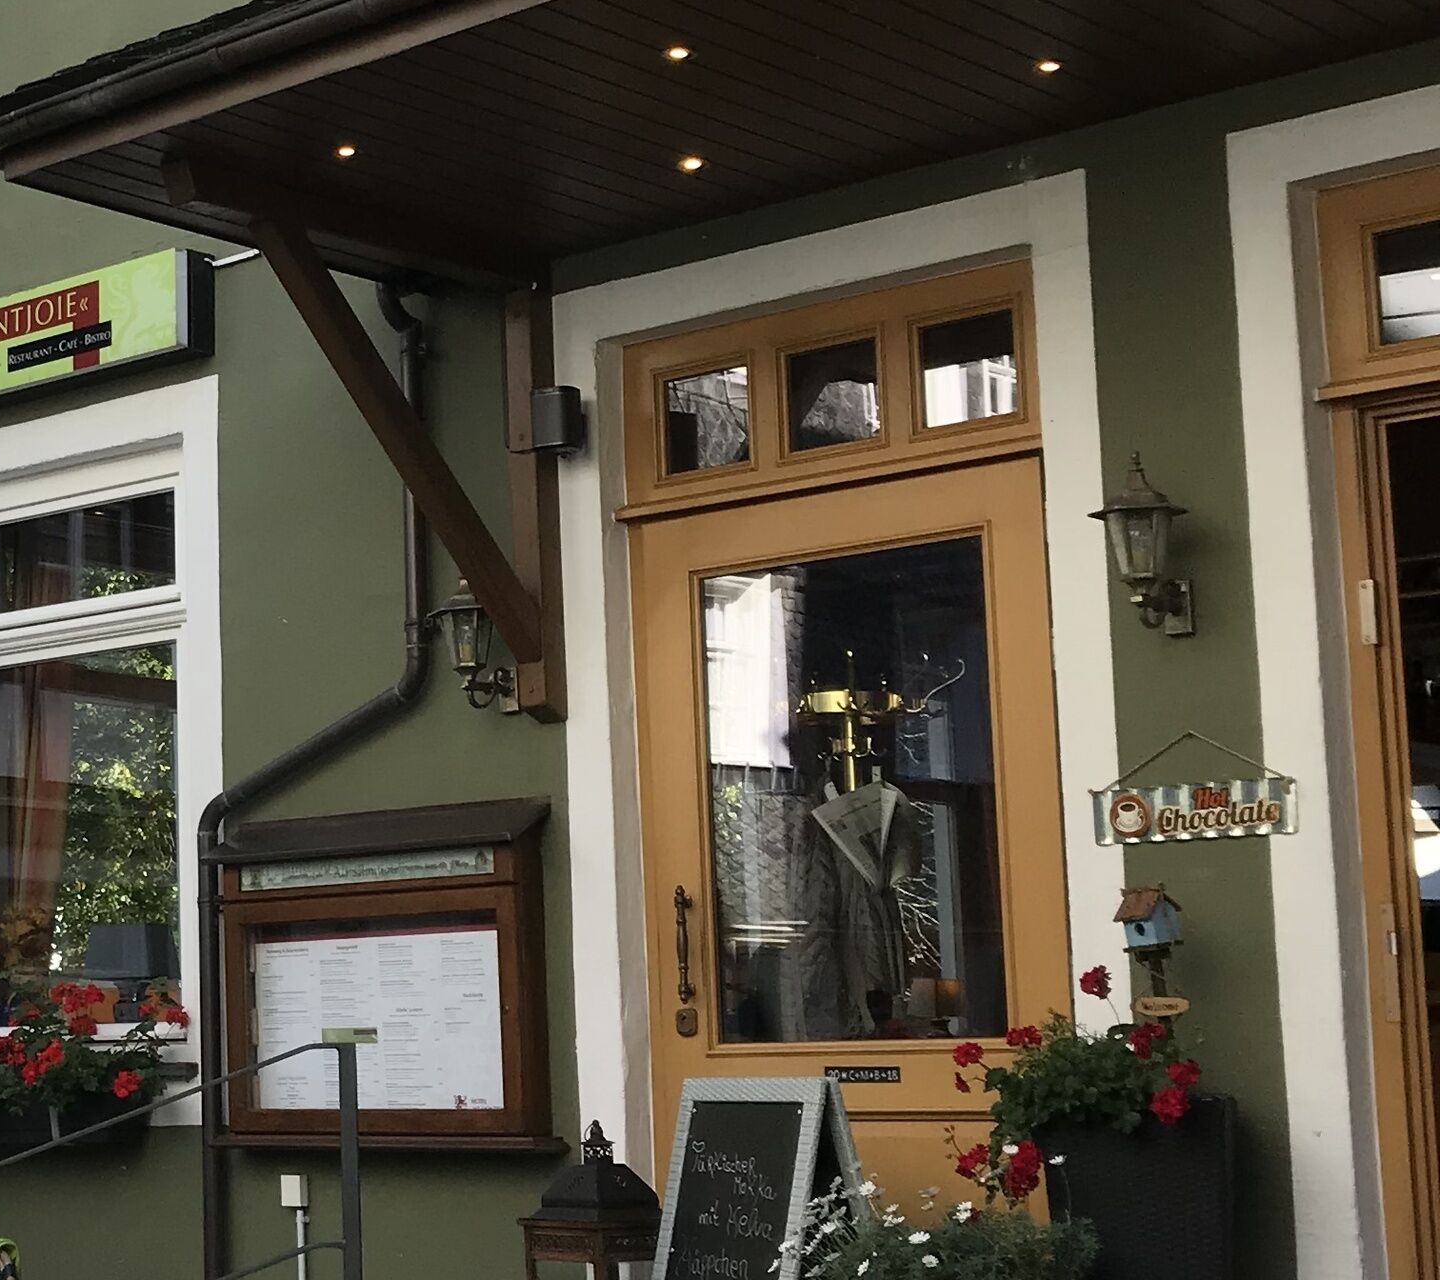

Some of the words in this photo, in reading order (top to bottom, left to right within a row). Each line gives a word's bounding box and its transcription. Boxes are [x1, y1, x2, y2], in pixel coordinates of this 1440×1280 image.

[1192, 786, 1231, 810] Hot
[1158, 799, 1281, 835] Chocolate
[698, 1199, 720, 1227] mit
